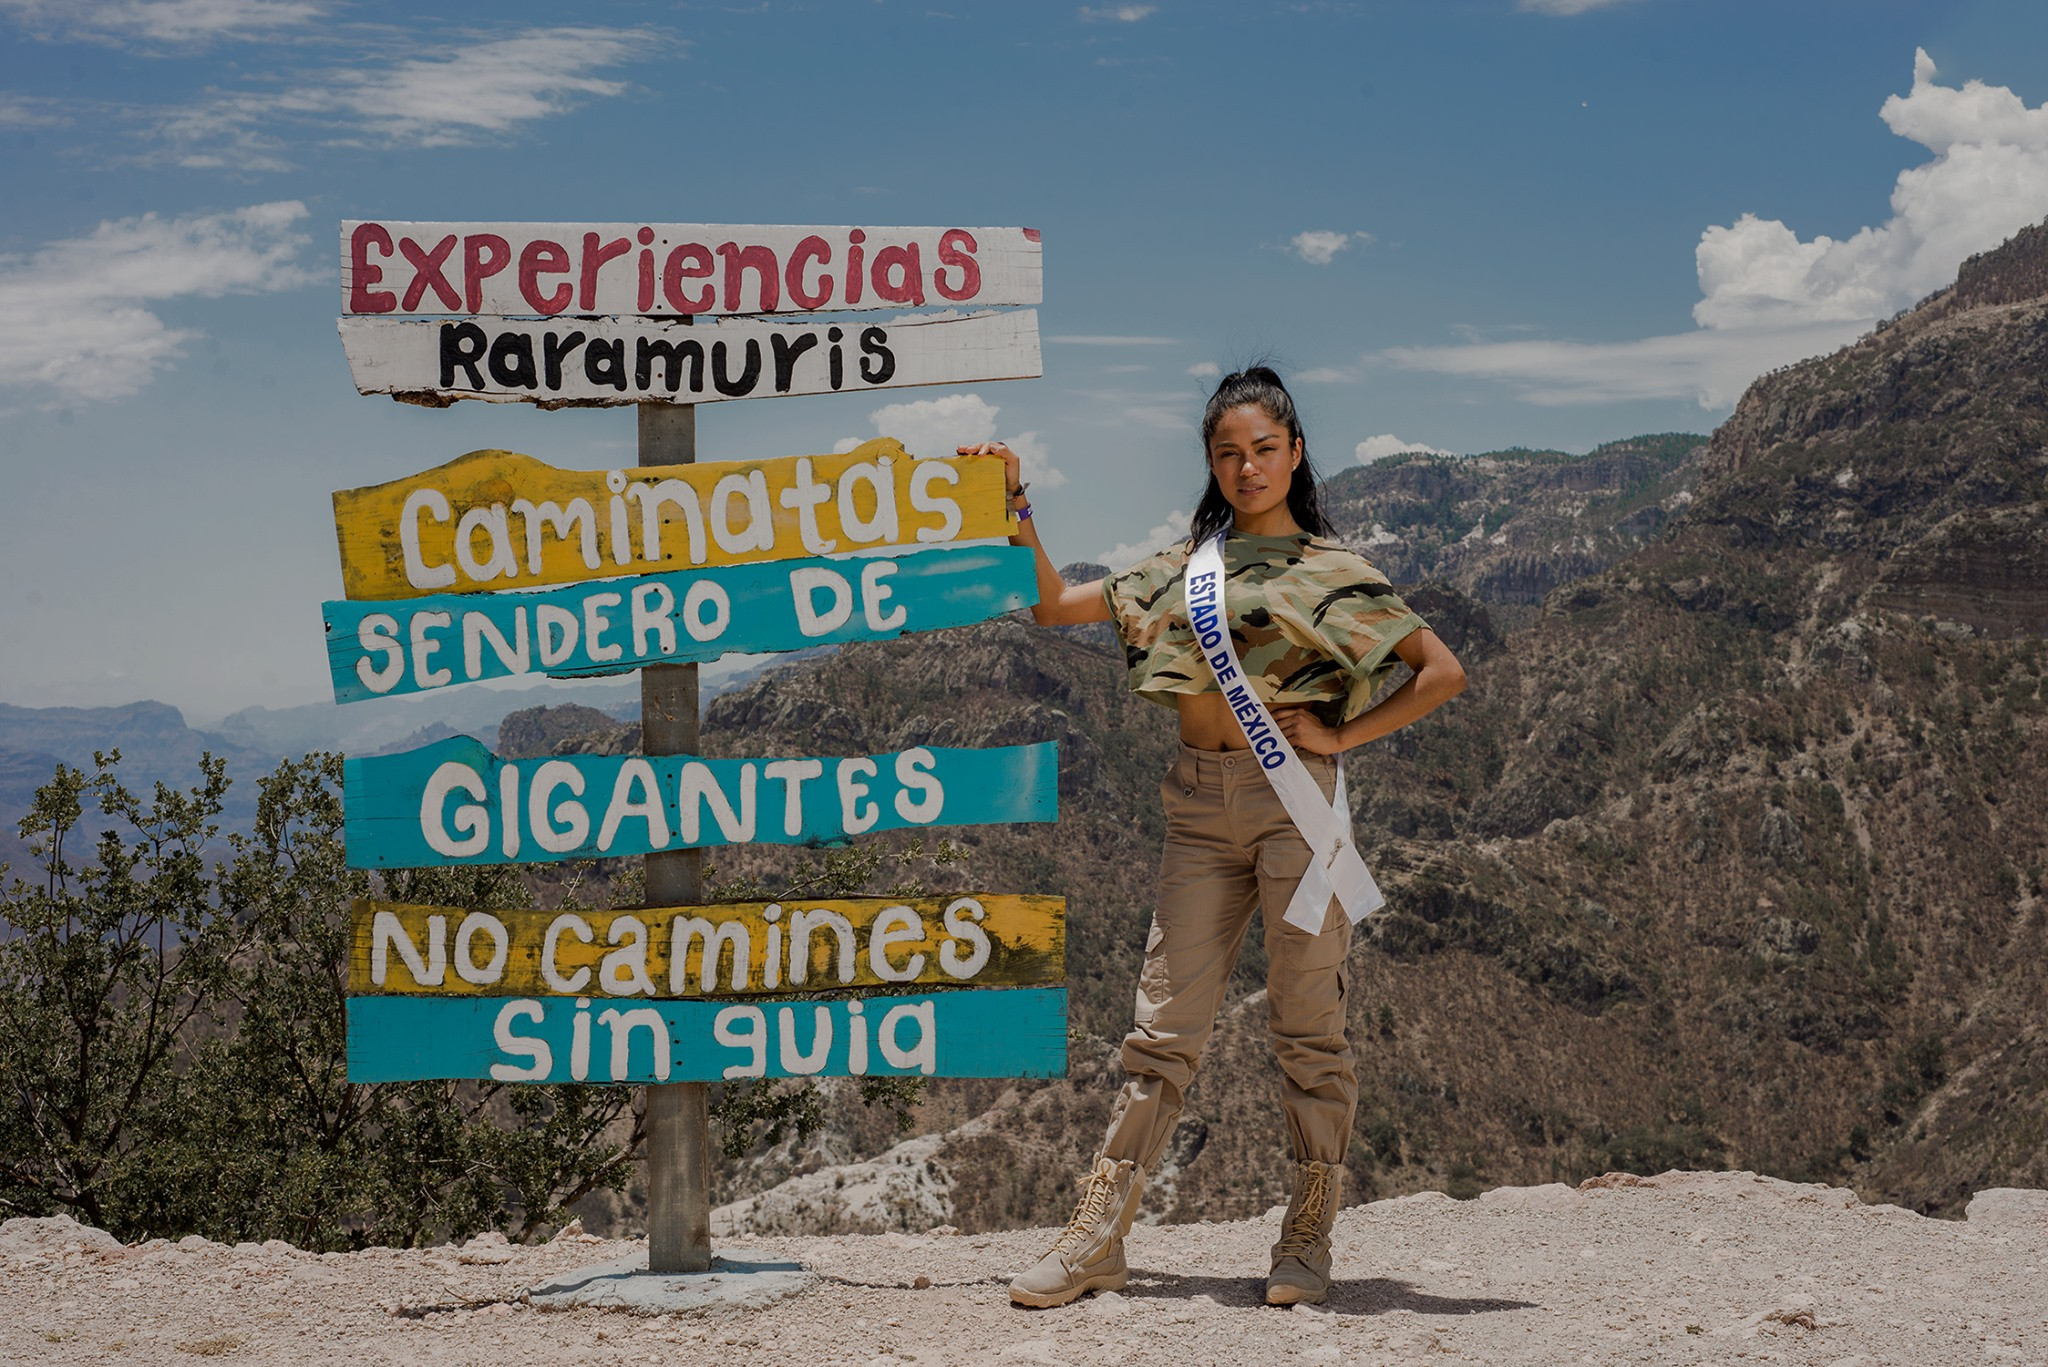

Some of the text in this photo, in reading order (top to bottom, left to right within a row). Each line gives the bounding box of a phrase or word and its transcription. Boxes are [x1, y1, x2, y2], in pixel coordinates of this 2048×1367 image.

[439, 323, 896, 396] Raramuris
[400, 455, 962, 589] Caminatas
[356, 561, 907, 694] SENDERO DE
[1190, 572, 1286, 770] ESTADO DE MÉXICO
[419, 747, 945, 858] GIGANTES
[713, 1000, 937, 1080] guia
